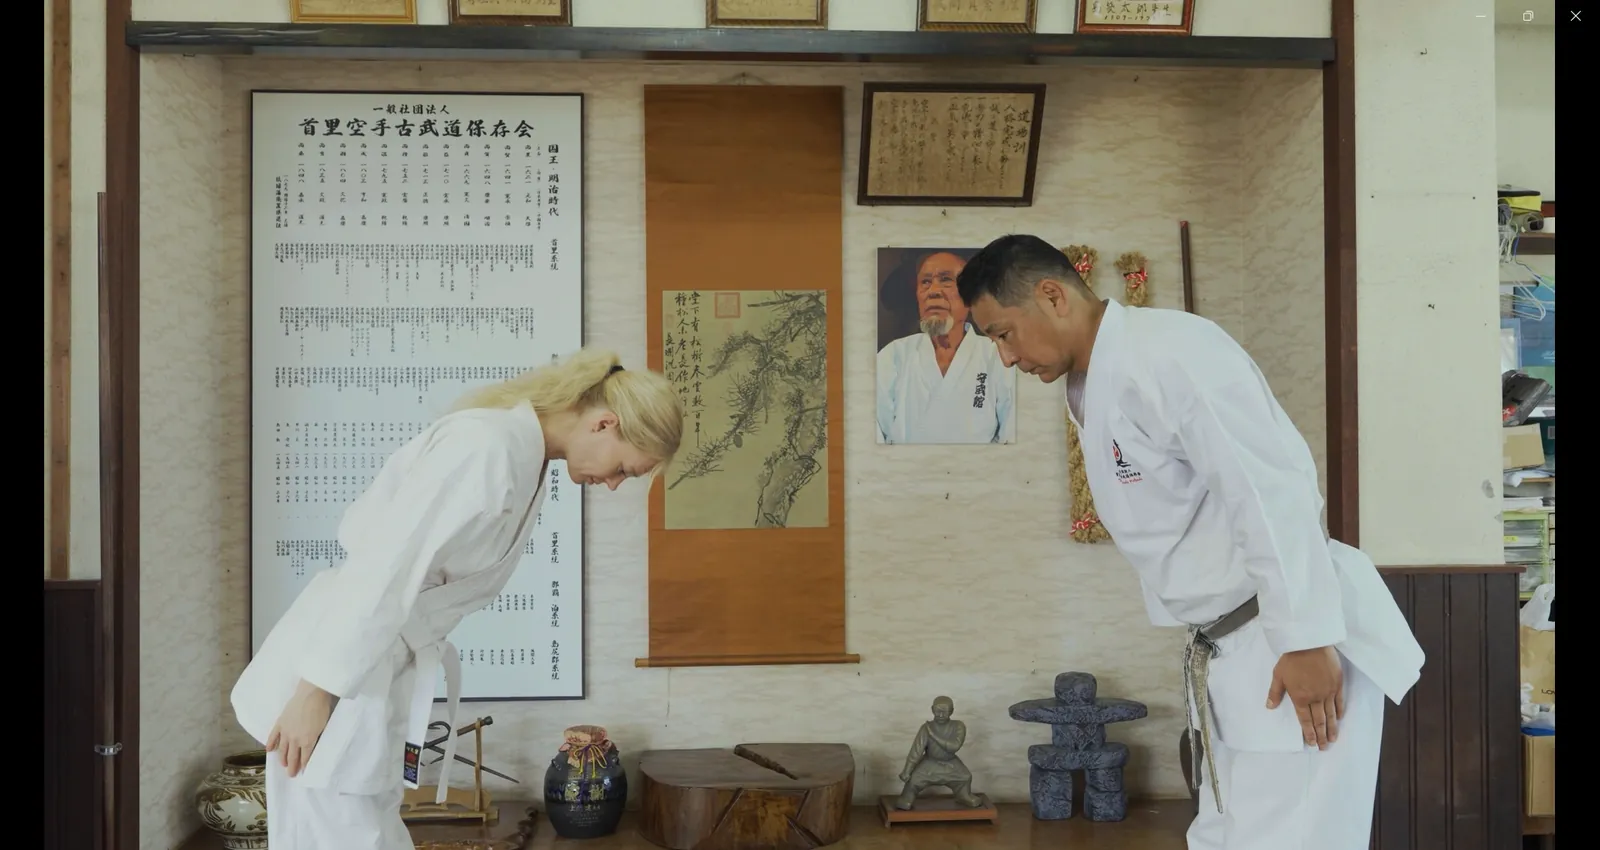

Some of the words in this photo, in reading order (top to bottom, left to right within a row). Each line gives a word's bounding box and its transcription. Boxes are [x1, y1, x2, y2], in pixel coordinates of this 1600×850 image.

[372, 103, 450, 115] 一般社団法人
[298, 117, 535, 138] 首里空手古武道保存会
